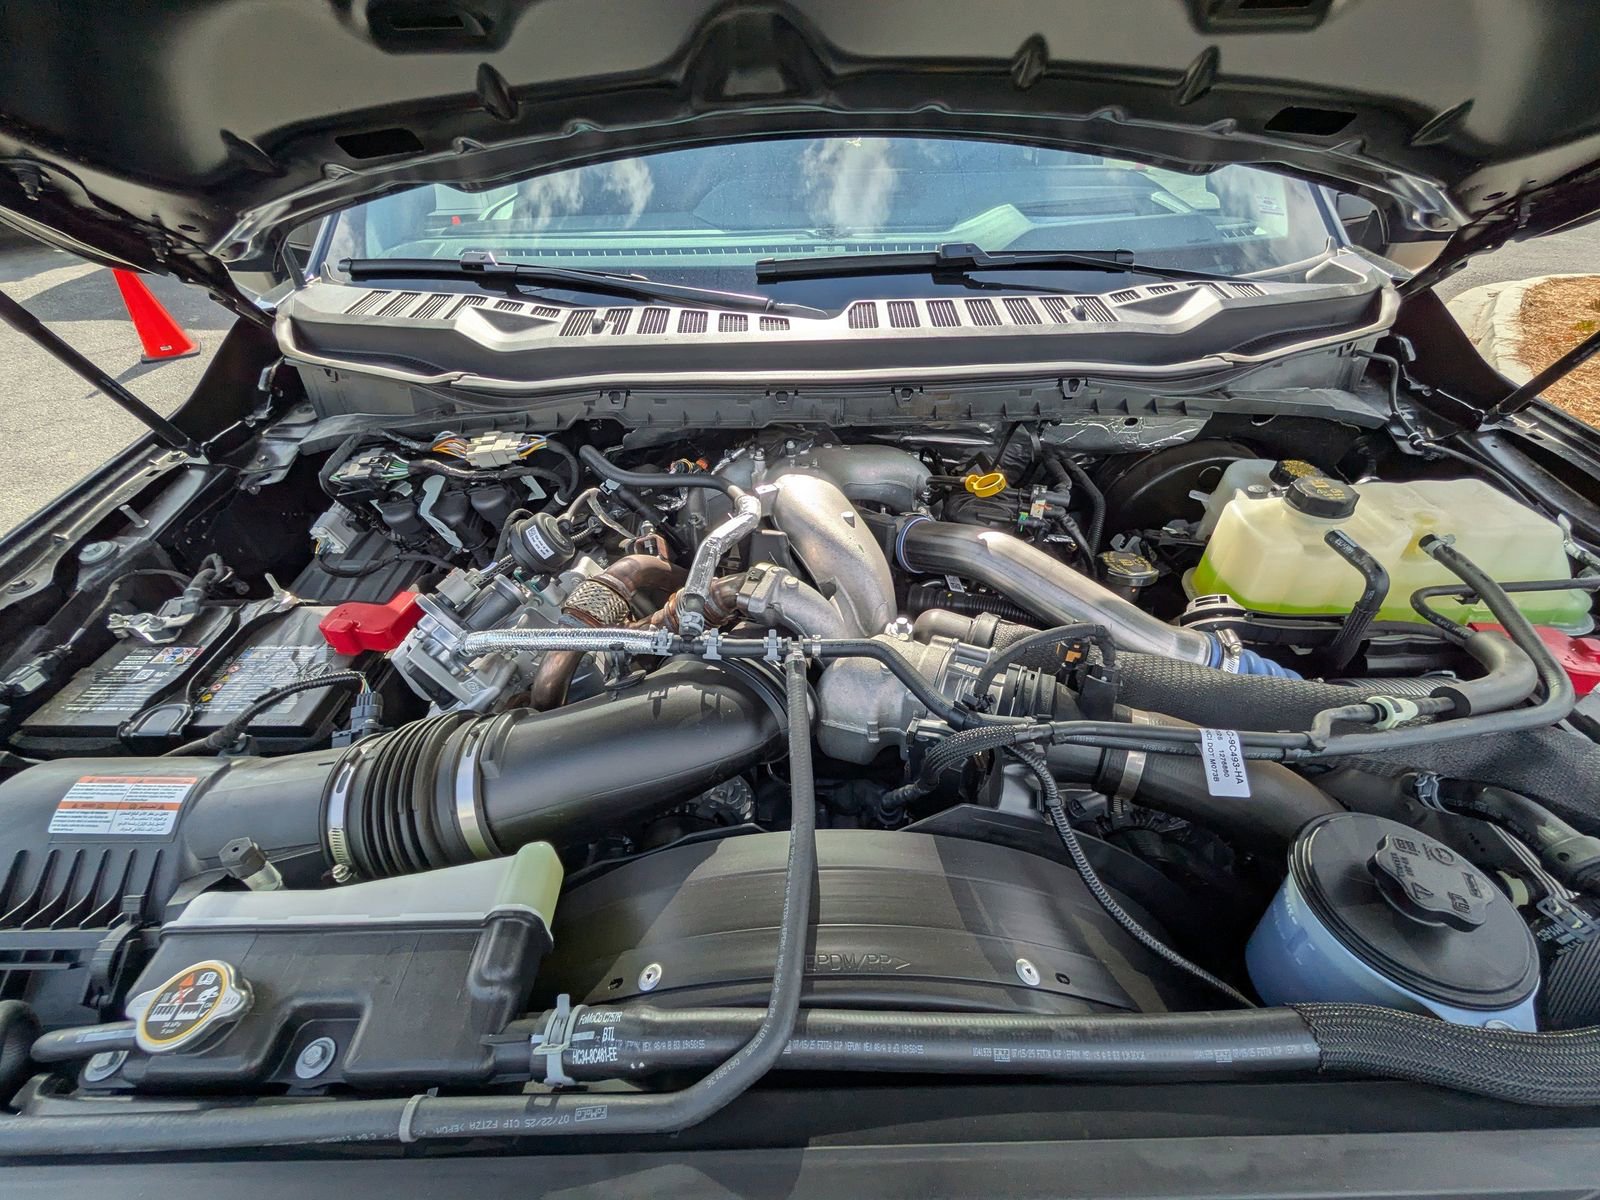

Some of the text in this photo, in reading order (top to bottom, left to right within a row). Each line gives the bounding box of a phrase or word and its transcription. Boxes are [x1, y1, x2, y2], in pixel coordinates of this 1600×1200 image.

[1207, 742, 1215, 756] DOT
[575, 1106, 607, 1120] FoMoCo
[503, 1118, 520, 1130] CIP
[525, 1114, 570, 1128] 07/22/25
